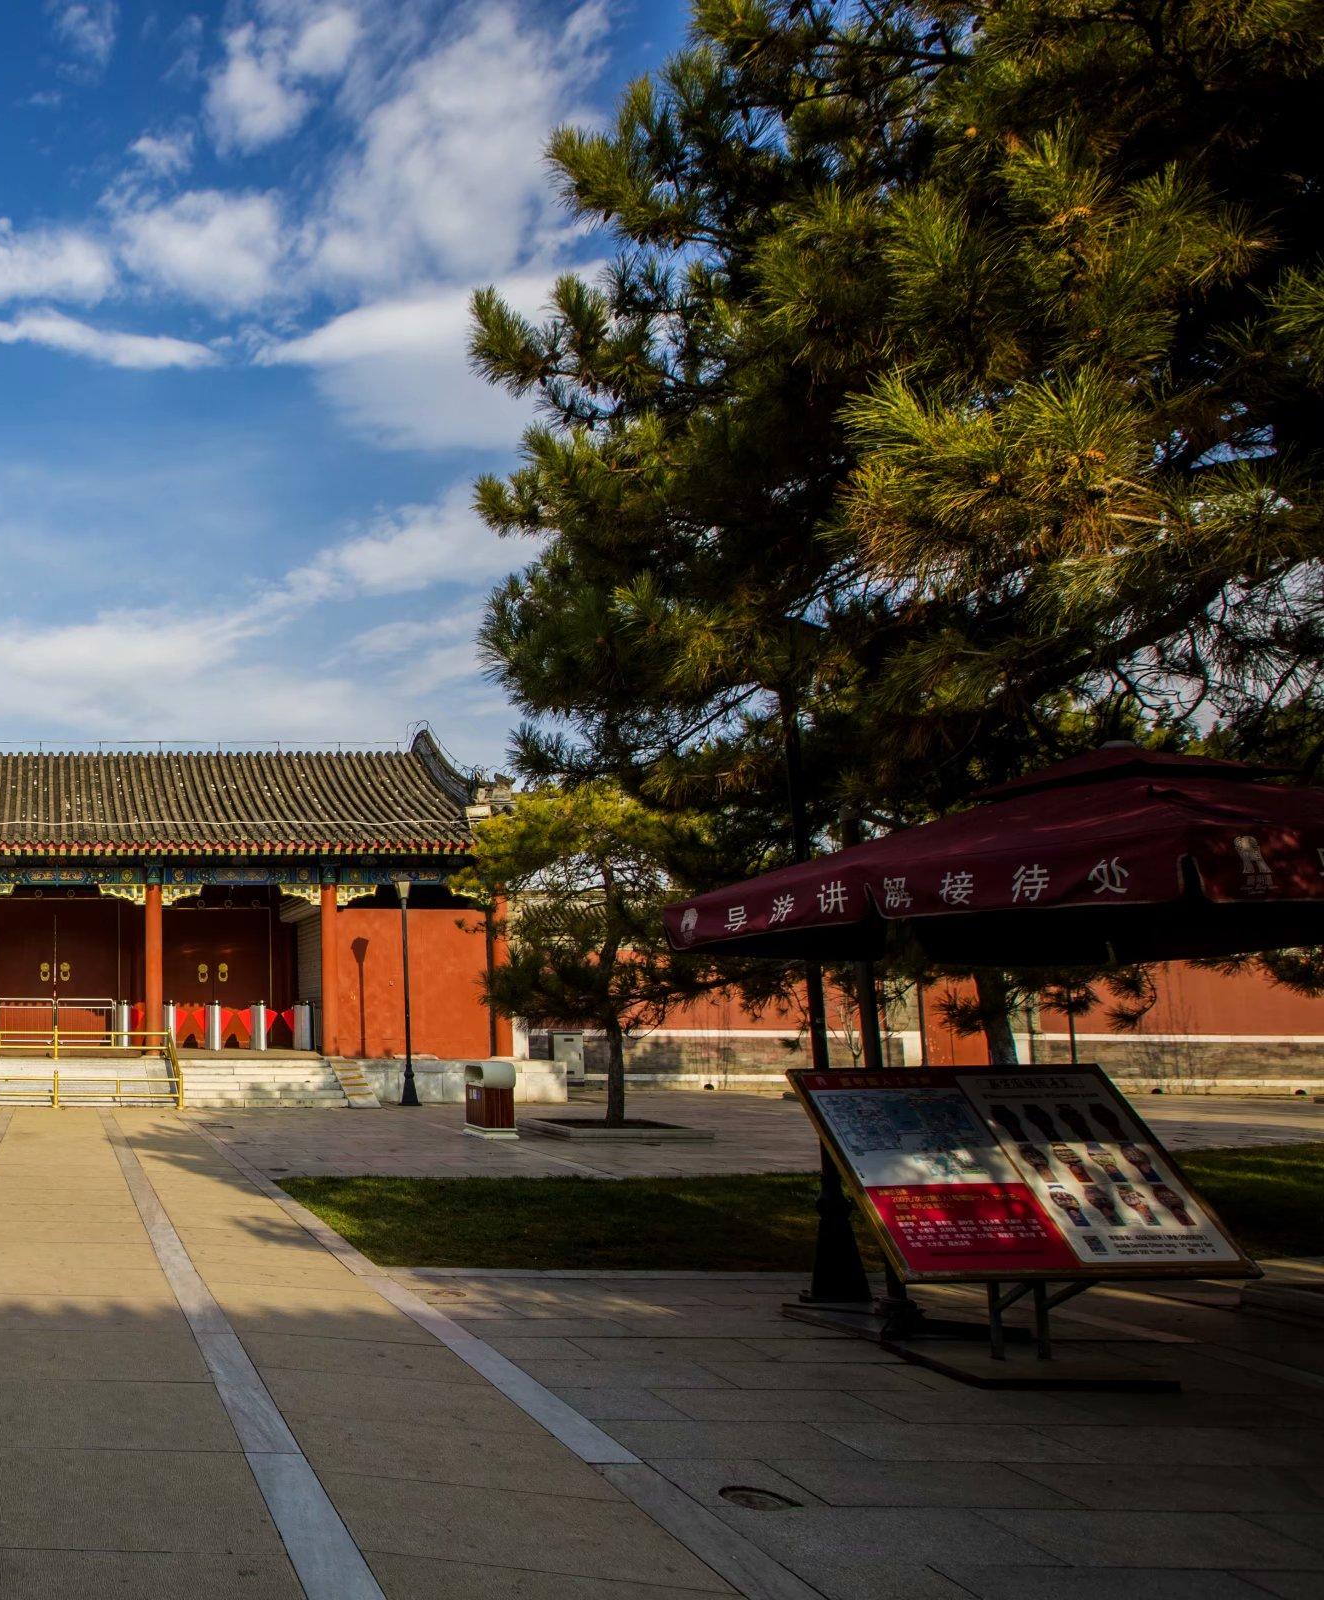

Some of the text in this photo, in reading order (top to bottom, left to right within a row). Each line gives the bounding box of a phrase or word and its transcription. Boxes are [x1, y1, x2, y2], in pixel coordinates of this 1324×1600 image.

[723, 856, 1129, 931] 导游讲解接待处
